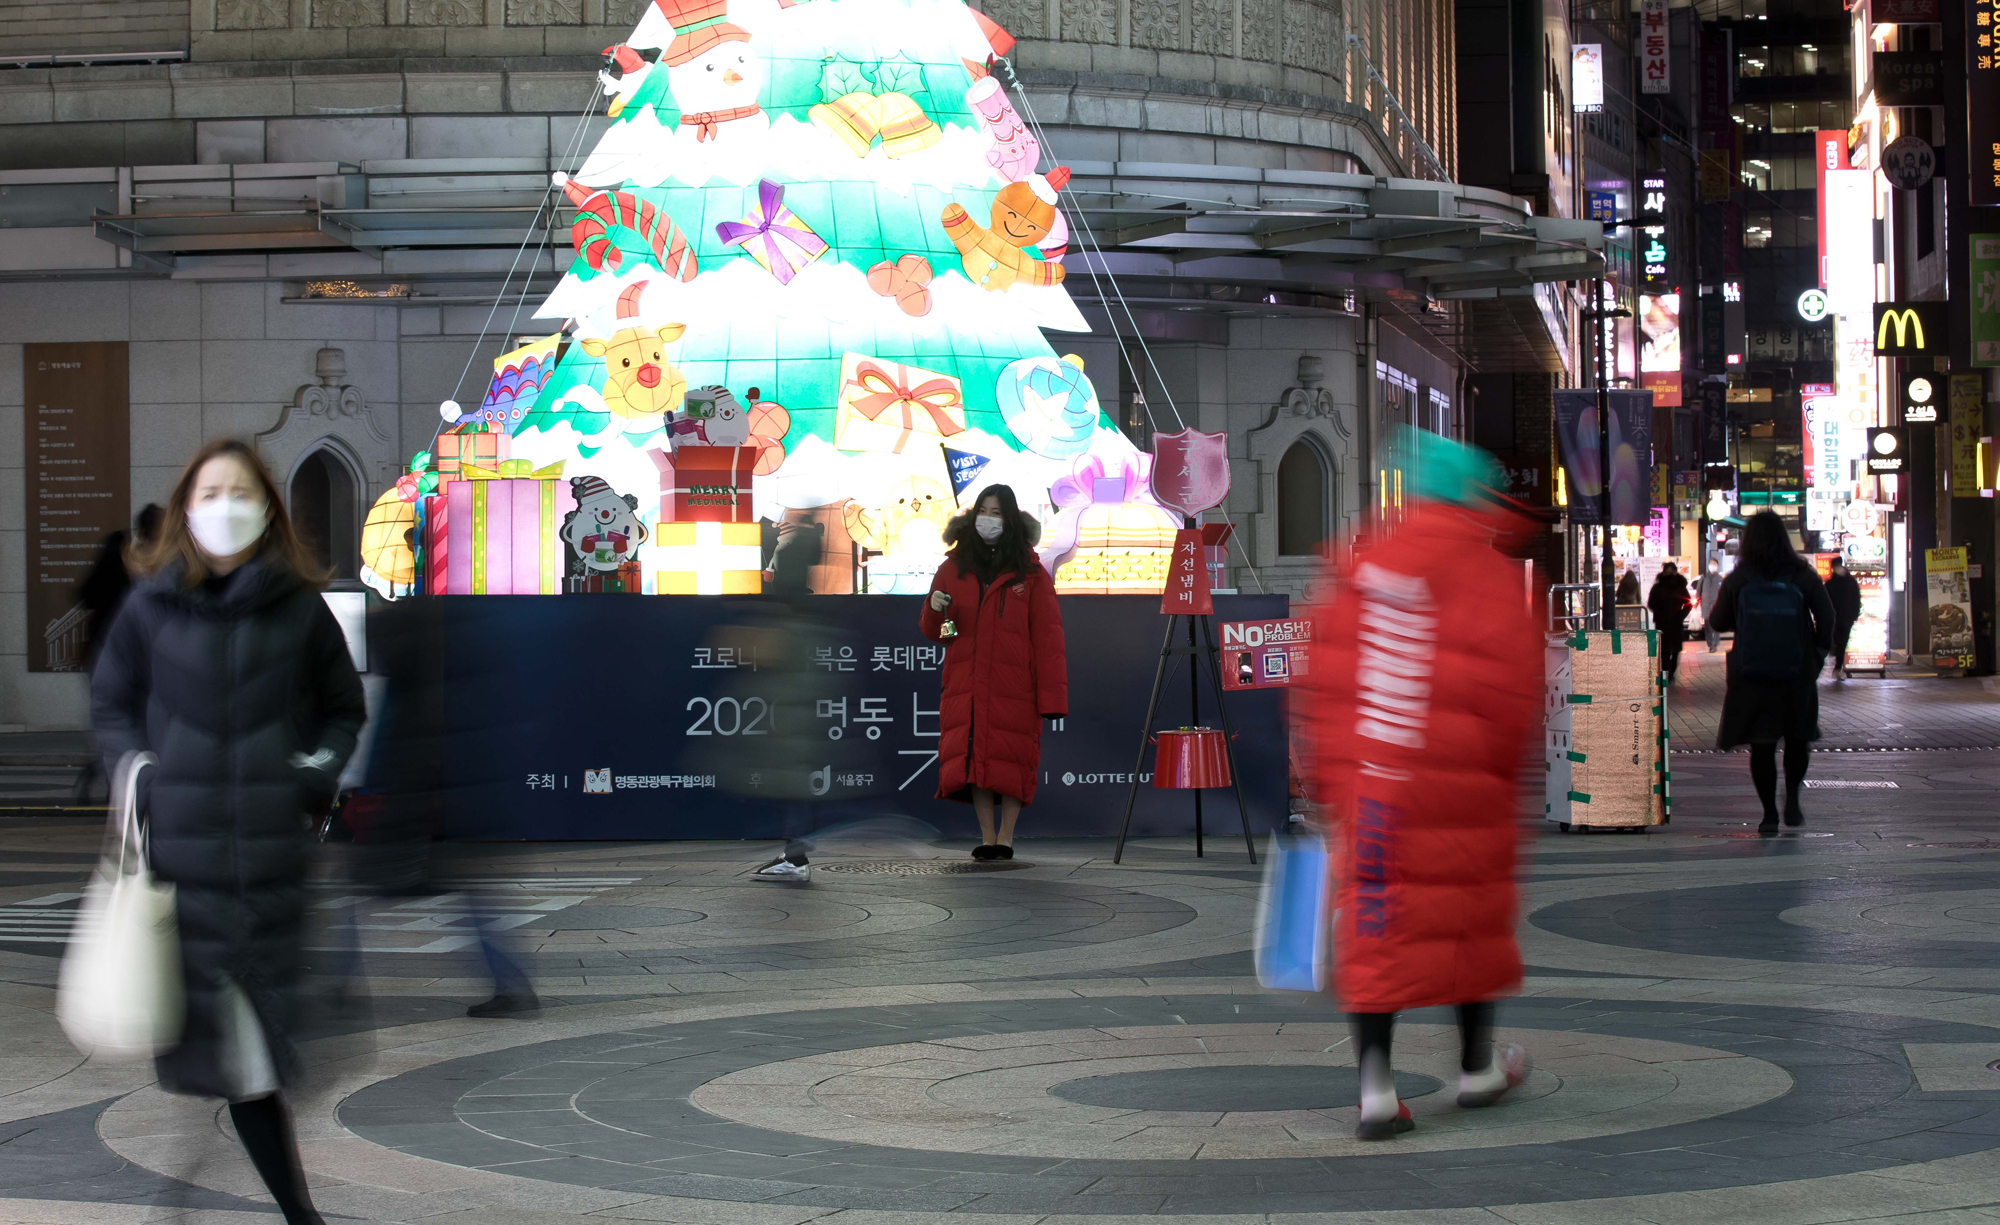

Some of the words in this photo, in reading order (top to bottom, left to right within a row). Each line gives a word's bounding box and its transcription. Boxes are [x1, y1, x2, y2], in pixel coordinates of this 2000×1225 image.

[1645, 12, 1667, 80] 부동산
[1880, 60, 1935, 75] Korea
[1826, 141, 1838, 170] RED
[1644, 179, 1664, 188] STAR
[1592, 199, 1612, 209] 번역
[1645, 264, 1666, 274] Cafe
[952, 455, 978, 469] VISIT
[1177, 439, 1201, 505] 구세군
[689, 484, 739, 497] MERRY
[687, 497, 742, 507] MEDIHEAL
[1847, 507, 1872, 531] 약
[1931, 547, 1960, 557] MONEY
[1931, 554, 1960, 562] EXCHANGE
[1179, 541, 1196, 605] 자선냄비
[1223, 623, 1263, 647] NO
[1264, 621, 1311, 635] CASH?
[1265, 632, 1311, 642] PROBLEM
[1958, 654, 1974, 668] 5F
[816, 696, 894, 740] 명동
[1629, 703, 1641, 751] Smart-Q
[525, 774, 556, 790] 주최
[614, 774, 716, 789] 명동관광특구협의회
[748, 771, 763, 788] 후
[836, 774, 875, 786] 서울중구
[1078, 773, 1125, 784] LOTTE
[1128, 773, 1155, 783] DU
